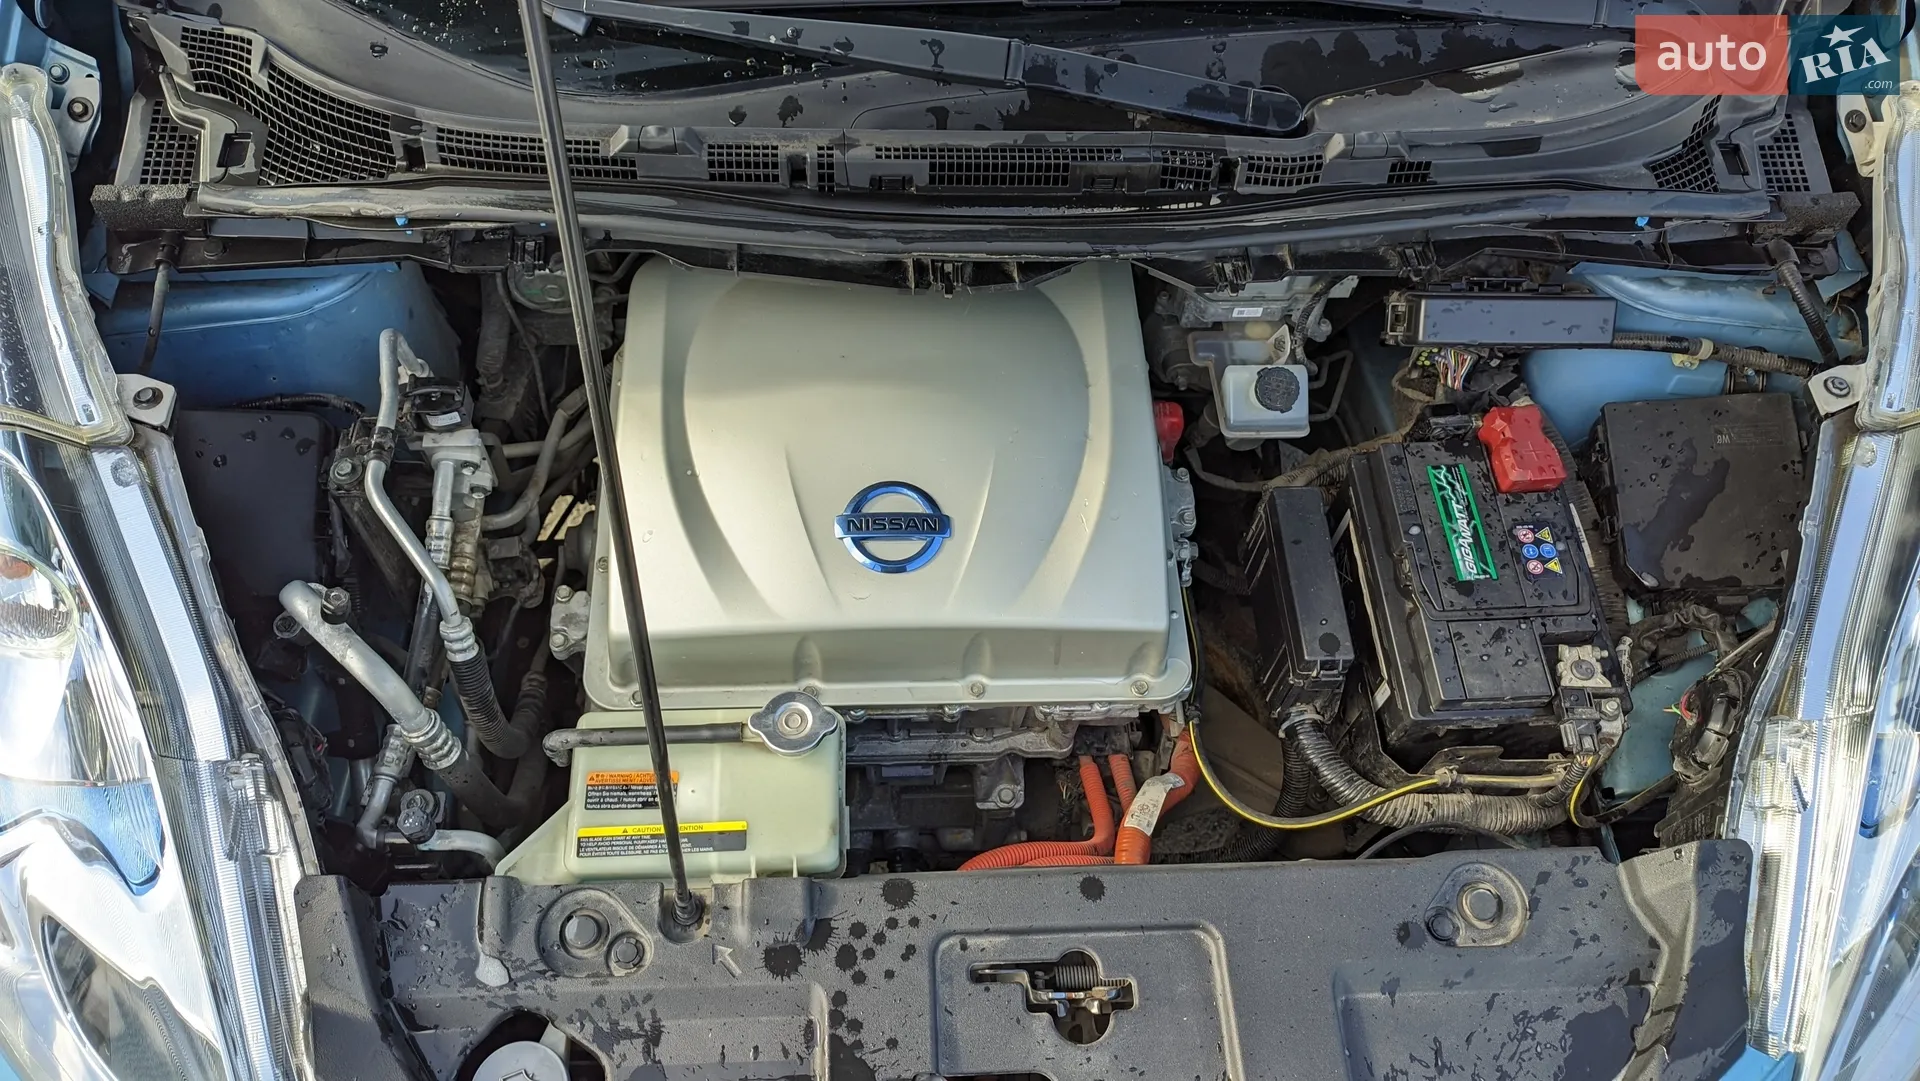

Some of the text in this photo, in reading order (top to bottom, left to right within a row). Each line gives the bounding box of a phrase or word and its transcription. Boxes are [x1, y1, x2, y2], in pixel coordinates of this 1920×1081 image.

[847, 517, 939, 532] NISSAN
[1453, 502, 1477, 574] GIGAWATT
[632, 826, 662, 834] CAUTION
